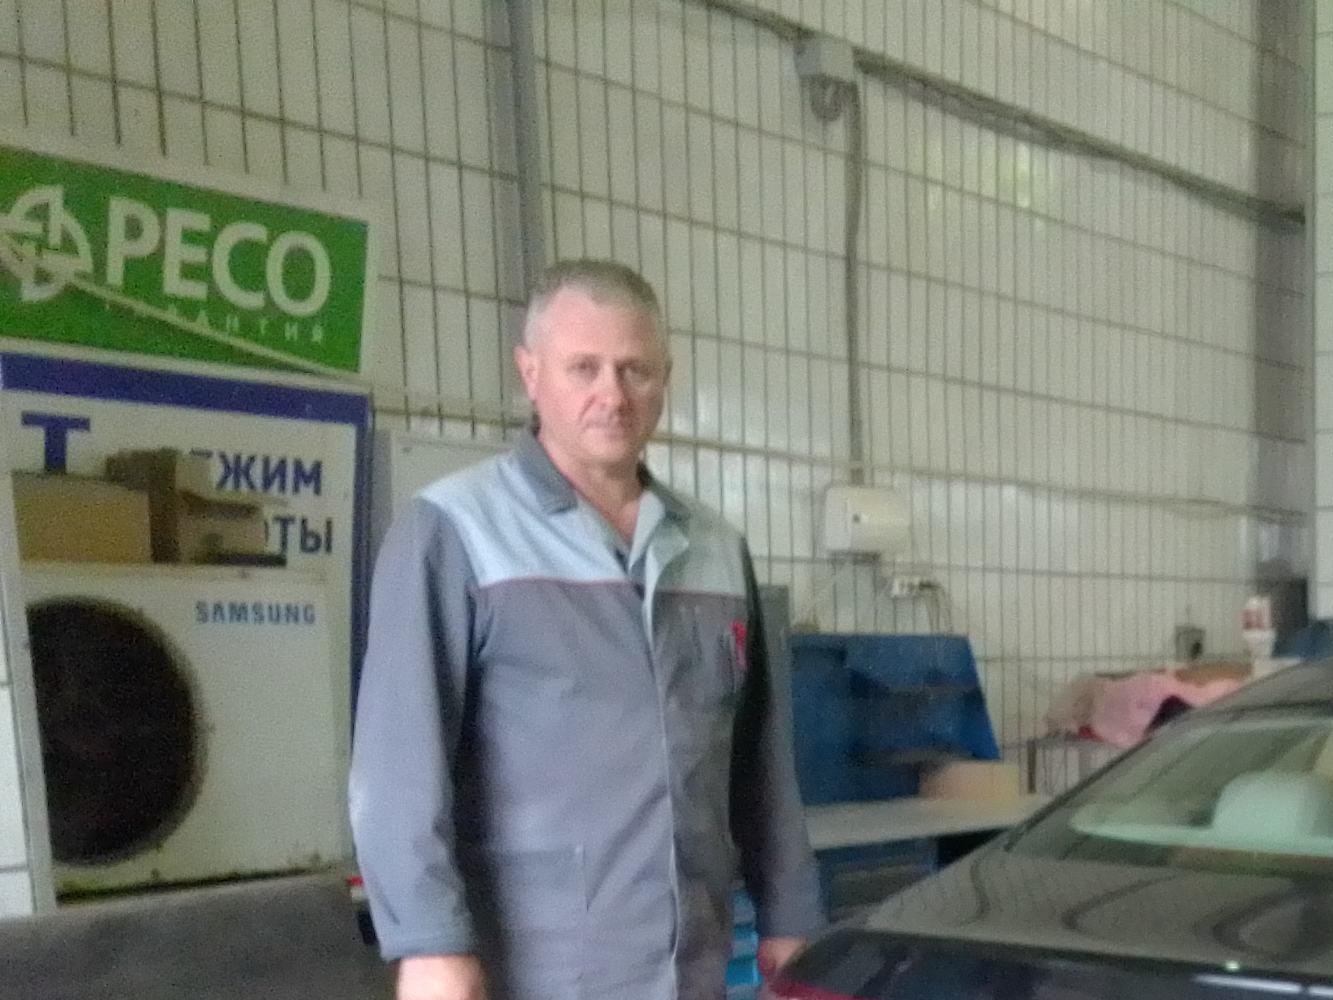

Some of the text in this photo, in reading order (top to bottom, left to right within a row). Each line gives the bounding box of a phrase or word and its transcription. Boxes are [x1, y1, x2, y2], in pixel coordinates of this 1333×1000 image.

[107, 196, 332, 317] РЕСО
[189, 449, 323, 496] ЖИМ
[195, 600, 316, 625] SAMSUNG
